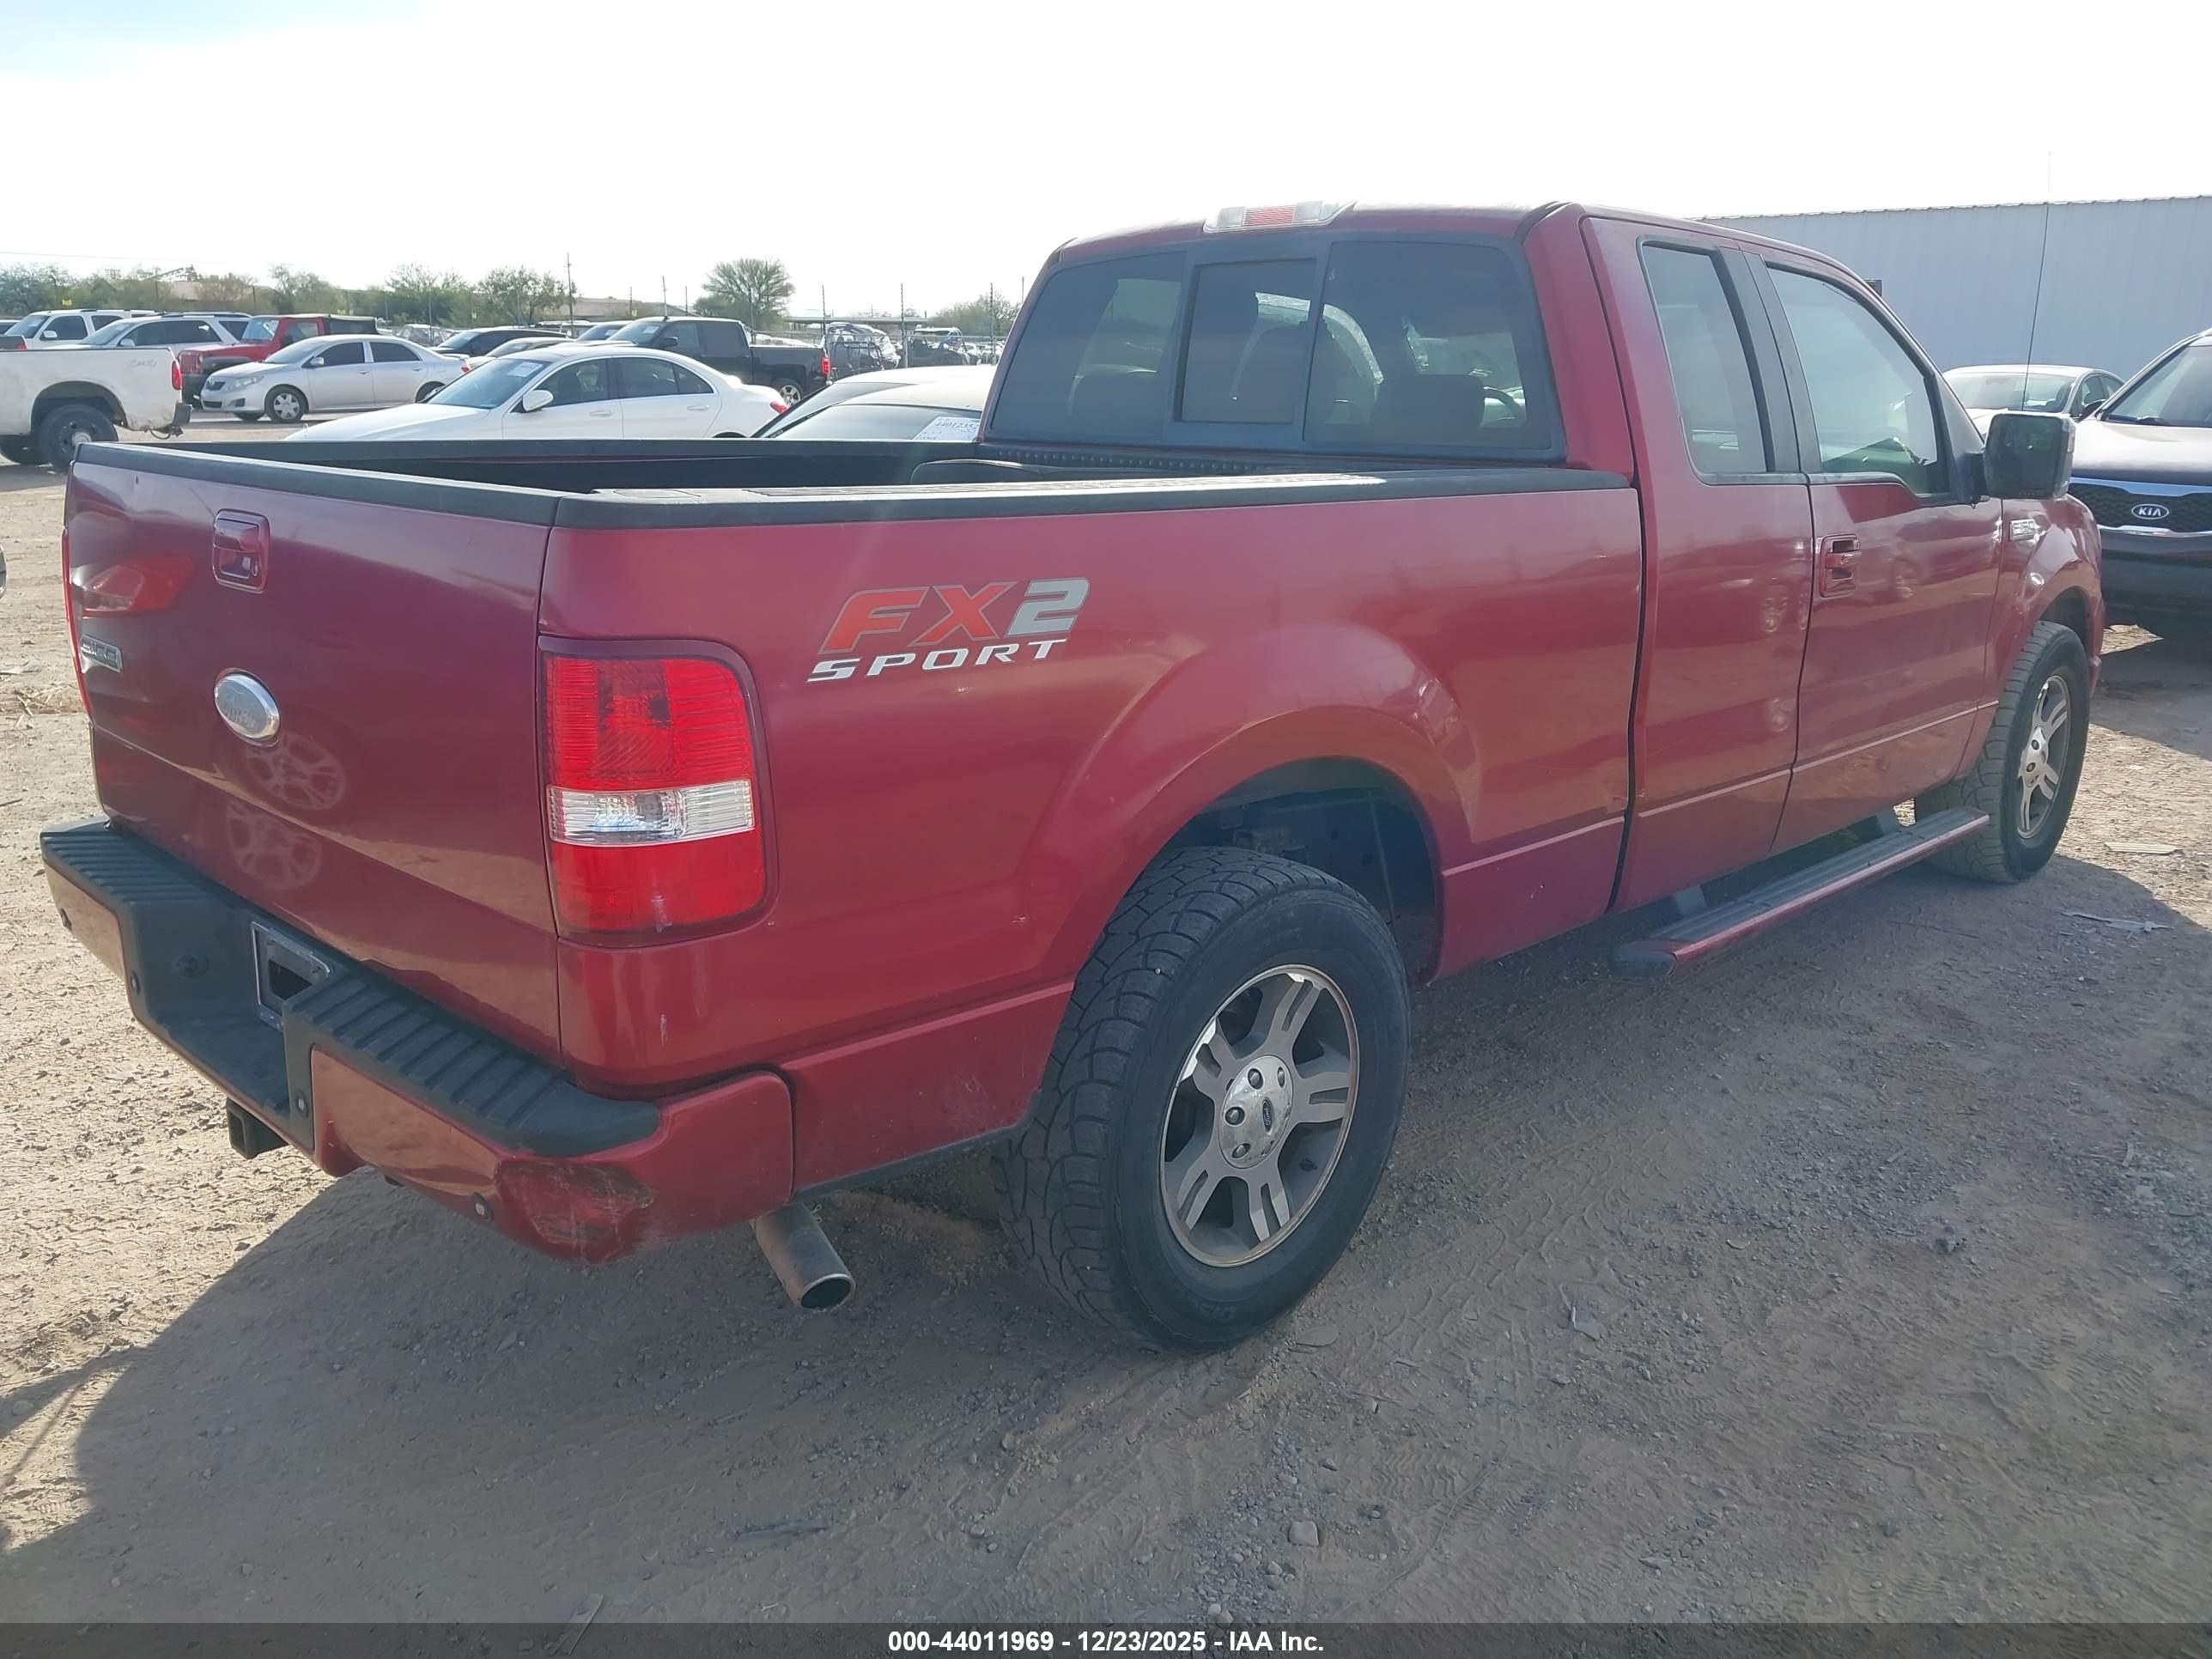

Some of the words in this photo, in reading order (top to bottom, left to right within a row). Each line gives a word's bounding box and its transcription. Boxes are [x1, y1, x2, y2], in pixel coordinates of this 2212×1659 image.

[2138, 507, 2161, 516] KIA
[817, 576, 1090, 655] FX2
[806, 638, 1067, 683] SPORT
